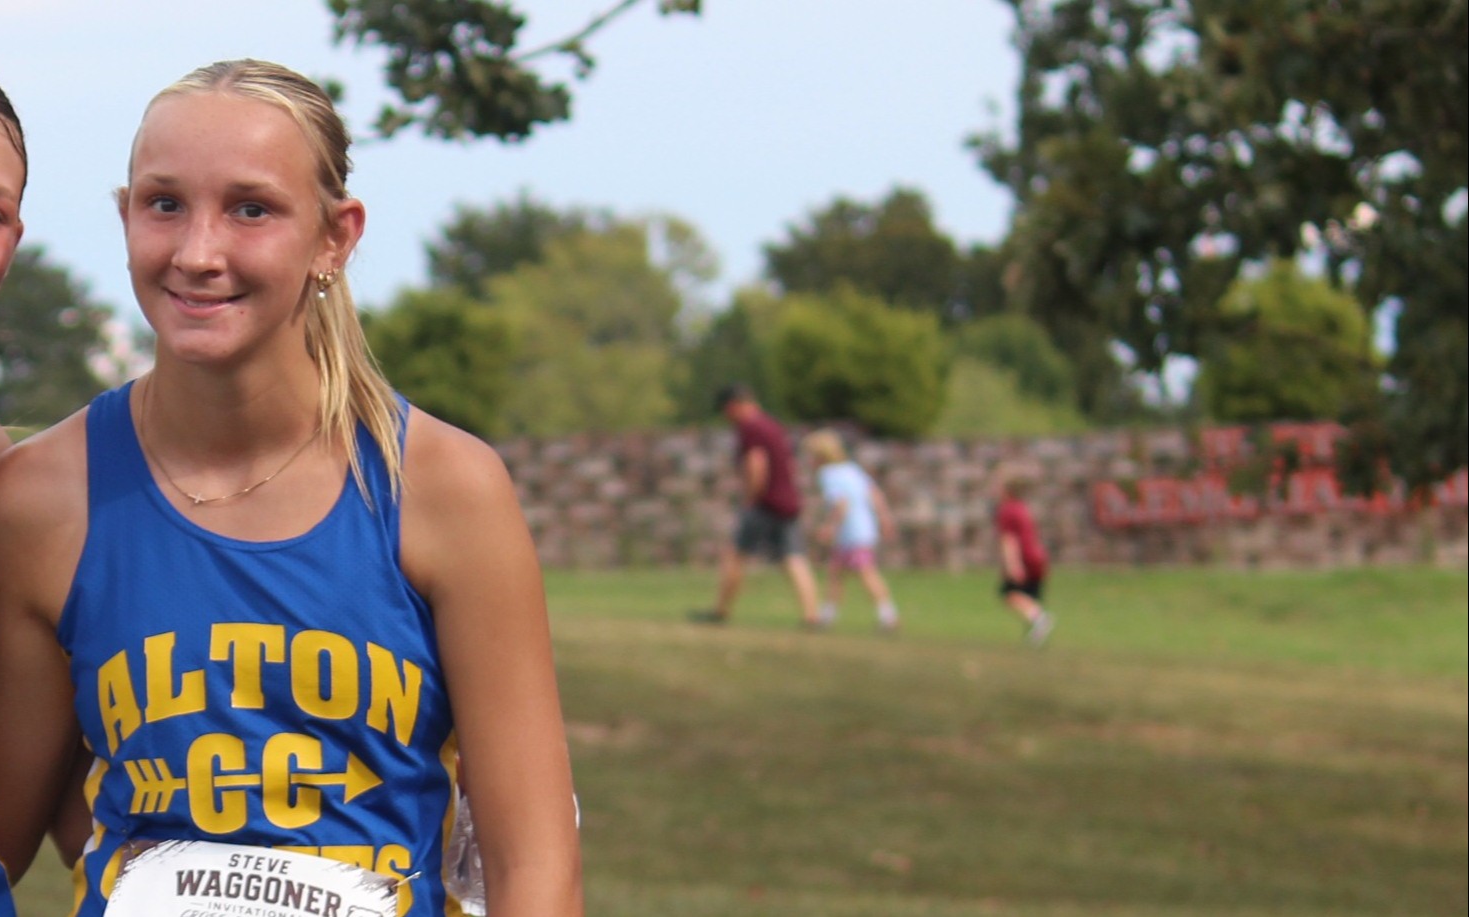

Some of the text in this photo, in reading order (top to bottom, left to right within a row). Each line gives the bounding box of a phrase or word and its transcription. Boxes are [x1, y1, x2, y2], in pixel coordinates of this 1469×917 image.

[98, 623, 422, 755] ALTON
[186, 732, 323, 835] CC
[175, 869, 342, 917] WAGGONER
[227, 853, 292, 875] STEVE
